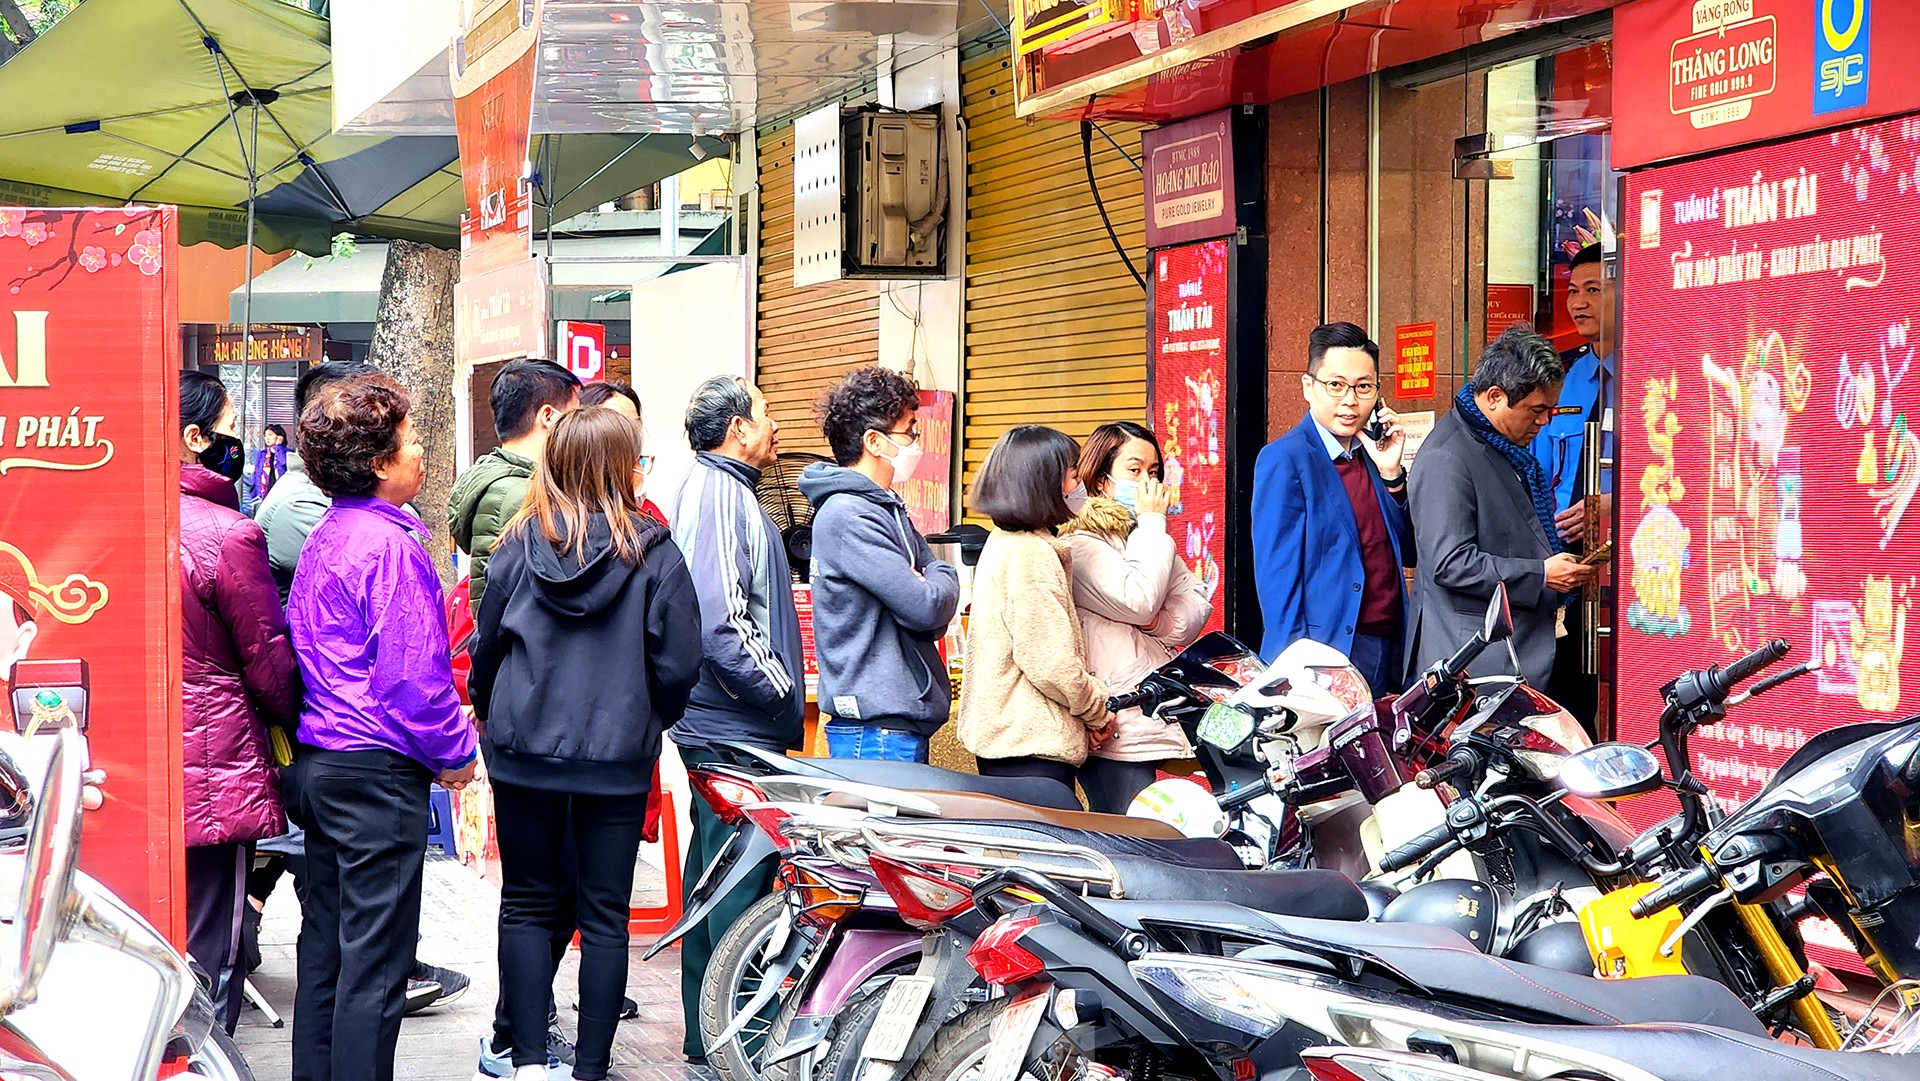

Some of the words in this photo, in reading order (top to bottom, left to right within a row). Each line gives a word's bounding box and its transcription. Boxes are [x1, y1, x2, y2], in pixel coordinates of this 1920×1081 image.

[1696, 4, 1722, 25] VÀNG
[1672, 47, 1726, 86] THĂNG
[1728, 36, 1773, 74] LONG
[1819, 53, 1864, 98] SJC
[1690, 83, 1708, 101] FINE
[1709, 79, 1728, 97] GOLD
[1730, 73, 1753, 92] 999.9
[1155, 164, 1183, 196] HOÀNG
[1184, 164, 1200, 190] KIM
[1201, 153, 1220, 186] BẢO
[1171, 148, 1187, 163] BTMC
[1161, 205, 1175, 219] PURE
[1176, 202, 1190, 217] GOLD
[1191, 197, 1216, 213] JEWELRY
[1781, 167, 1818, 219] TÀI
[15, 405, 105, 448] PHÁT
